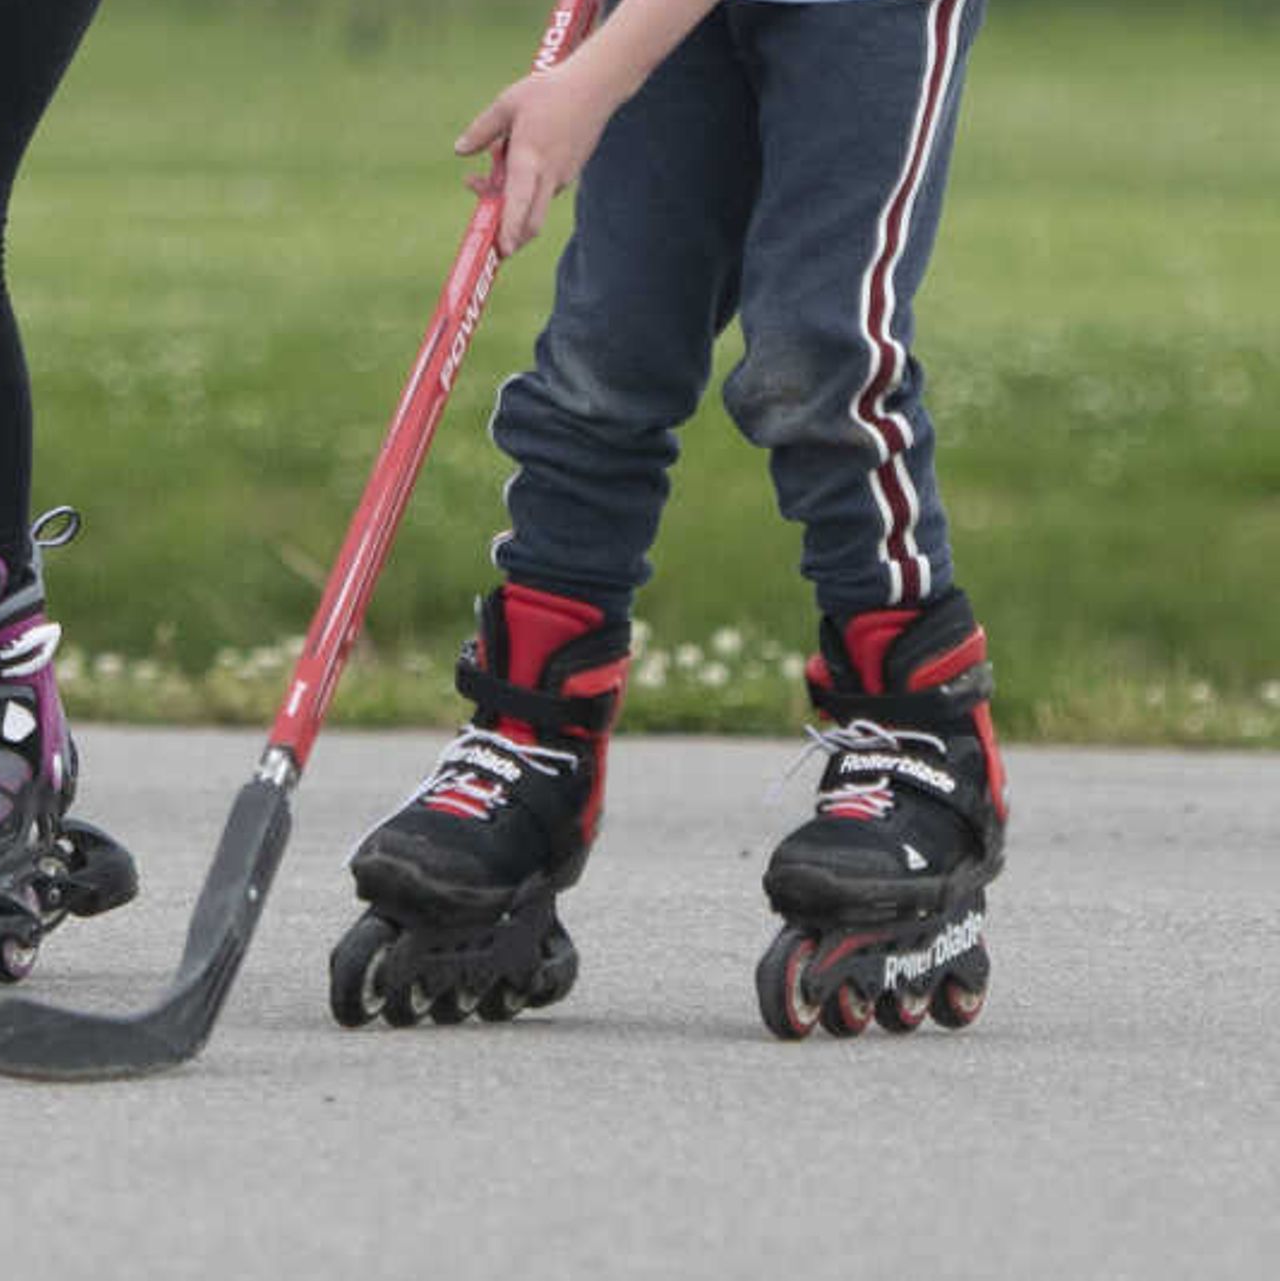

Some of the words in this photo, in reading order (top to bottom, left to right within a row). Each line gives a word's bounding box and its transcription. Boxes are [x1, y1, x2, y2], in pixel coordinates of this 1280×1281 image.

[440, 244, 498, 392] POWER
[840, 754, 956, 794] Rollerblade
[883, 910, 983, 990] Rollerblade
